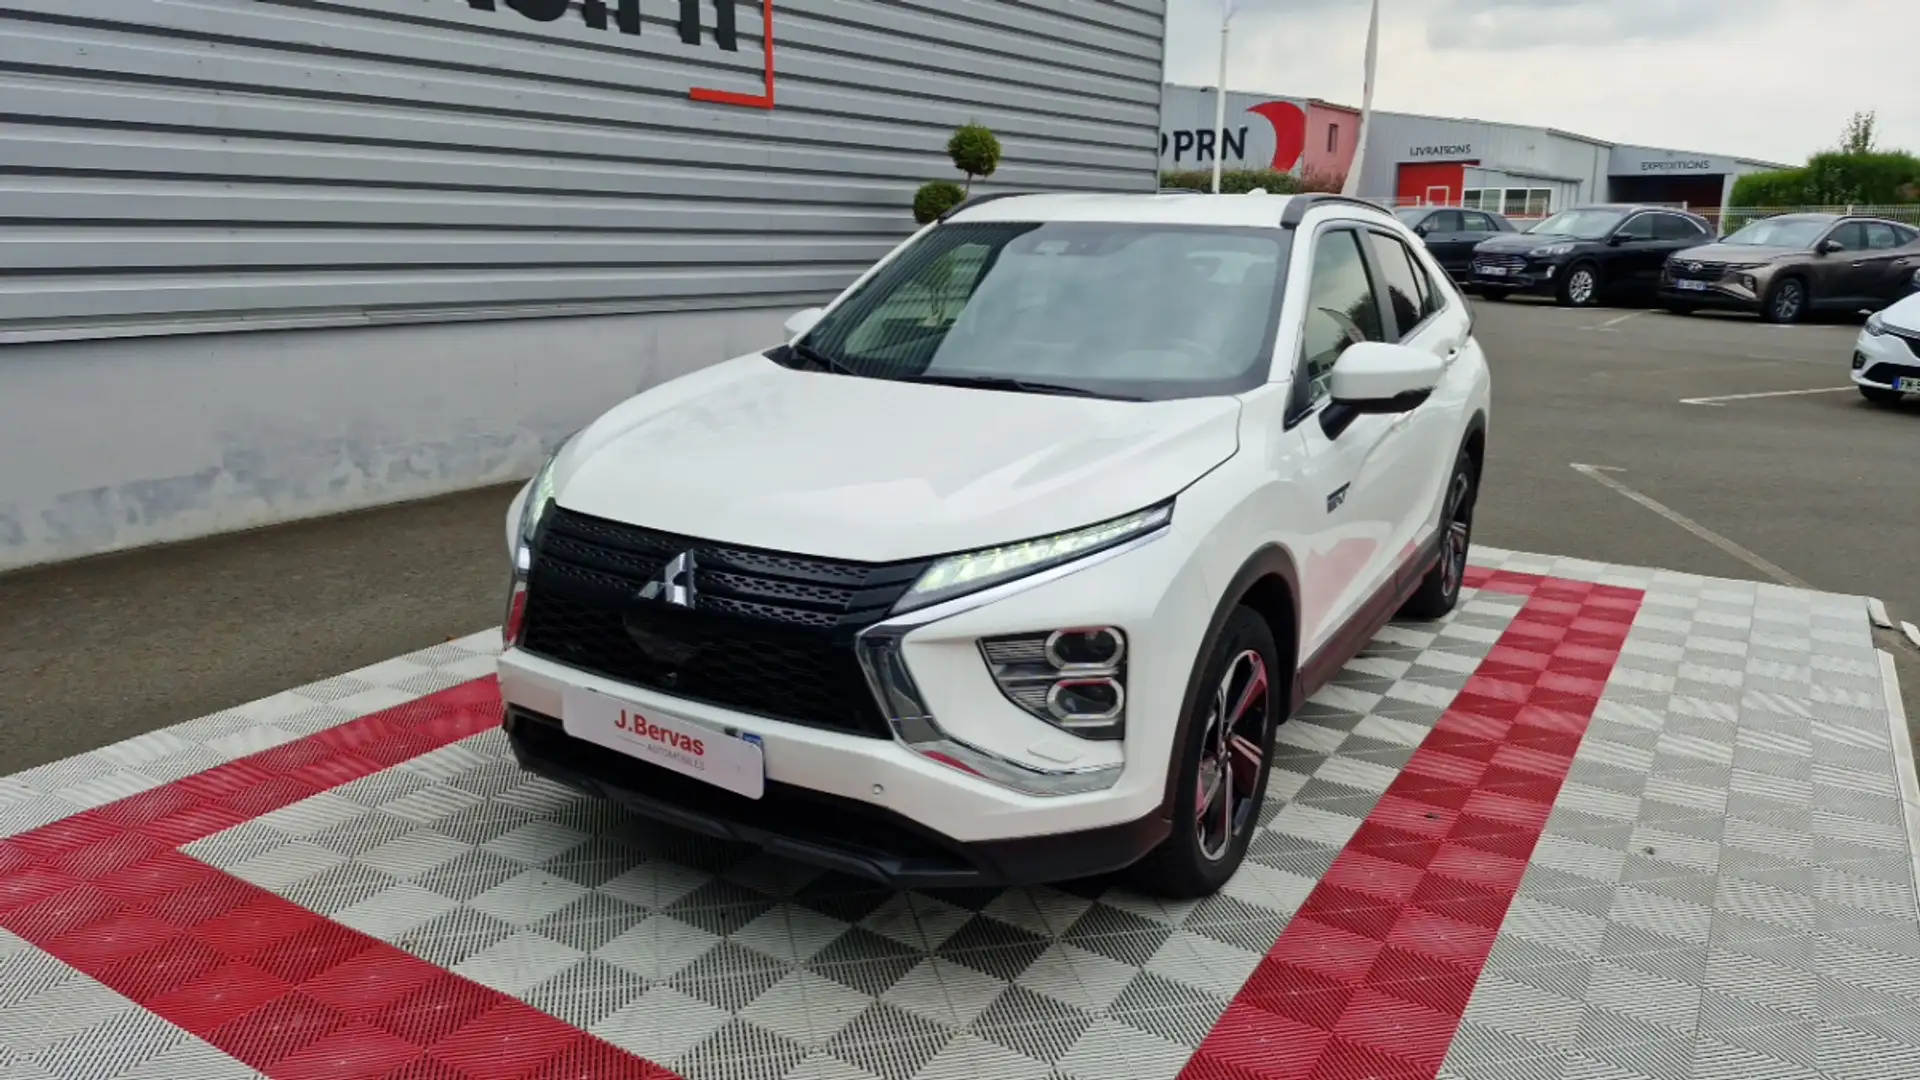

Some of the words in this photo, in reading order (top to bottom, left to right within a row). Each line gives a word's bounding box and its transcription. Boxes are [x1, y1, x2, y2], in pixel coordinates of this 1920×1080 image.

[1161, 125, 1248, 162] PRN
[1409, 144, 1472, 157] LIVRAISONS
[614, 709, 705, 757] J.Bervas
